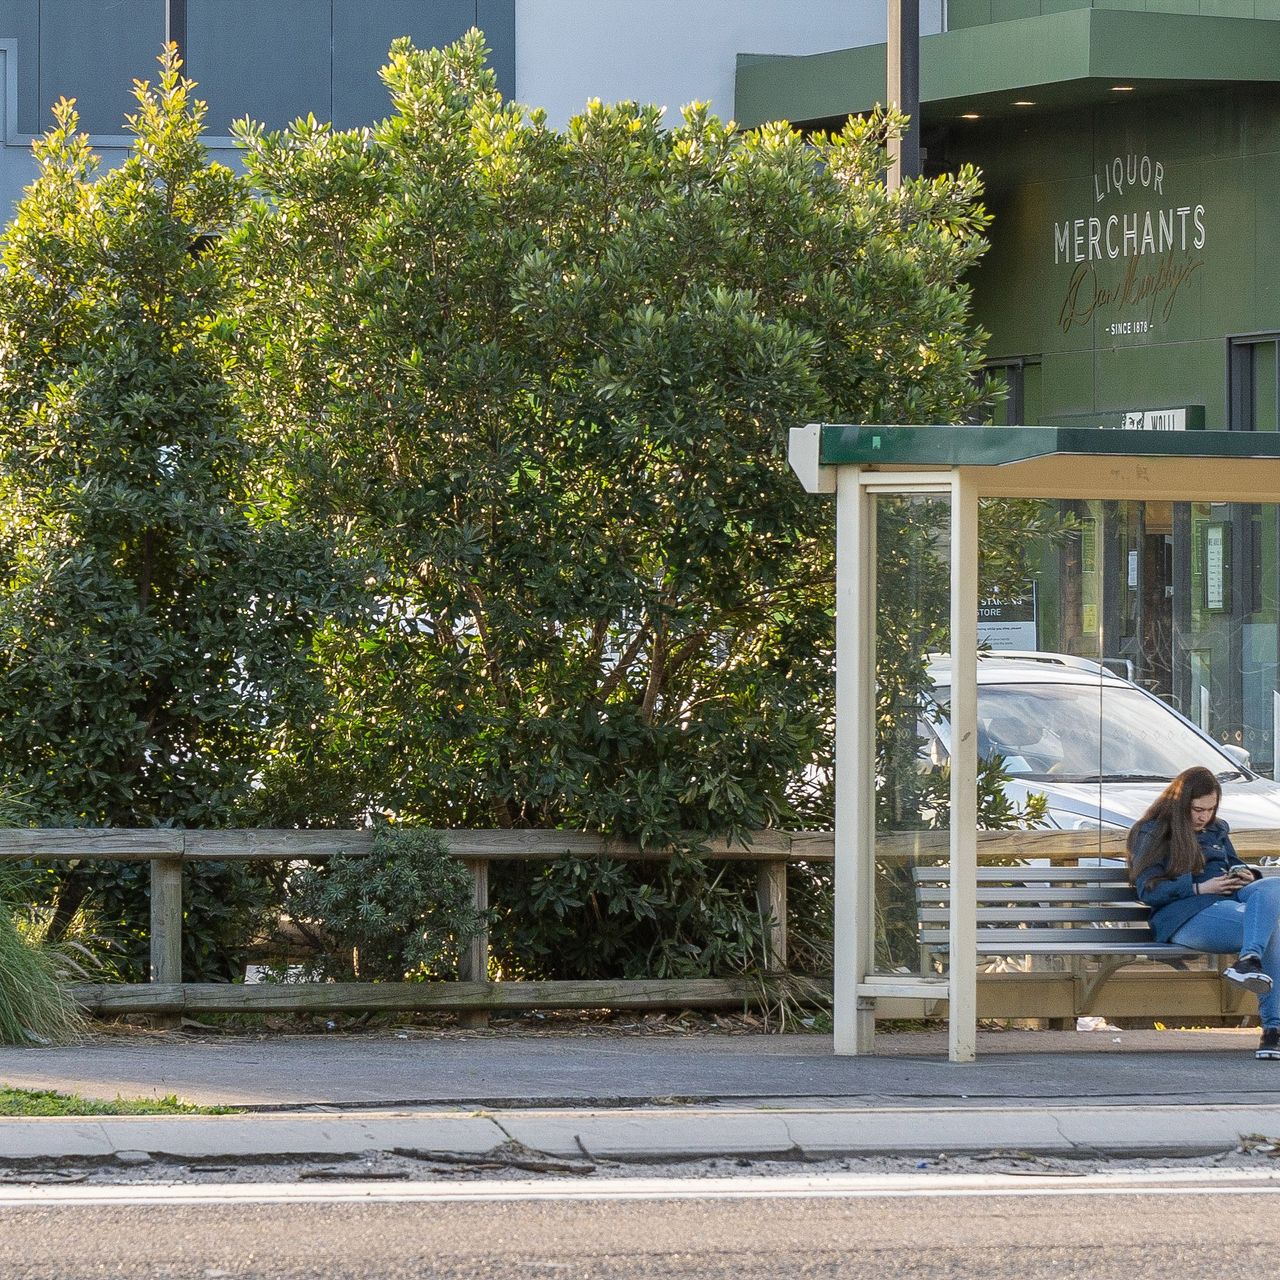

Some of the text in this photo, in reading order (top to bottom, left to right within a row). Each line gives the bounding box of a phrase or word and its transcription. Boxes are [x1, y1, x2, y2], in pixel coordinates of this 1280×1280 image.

[1094, 154, 1164, 202] LIQUOR
[1054, 204, 1206, 264] MERCHANTS
[1110, 320, 1149, 336] SINCE 1878
